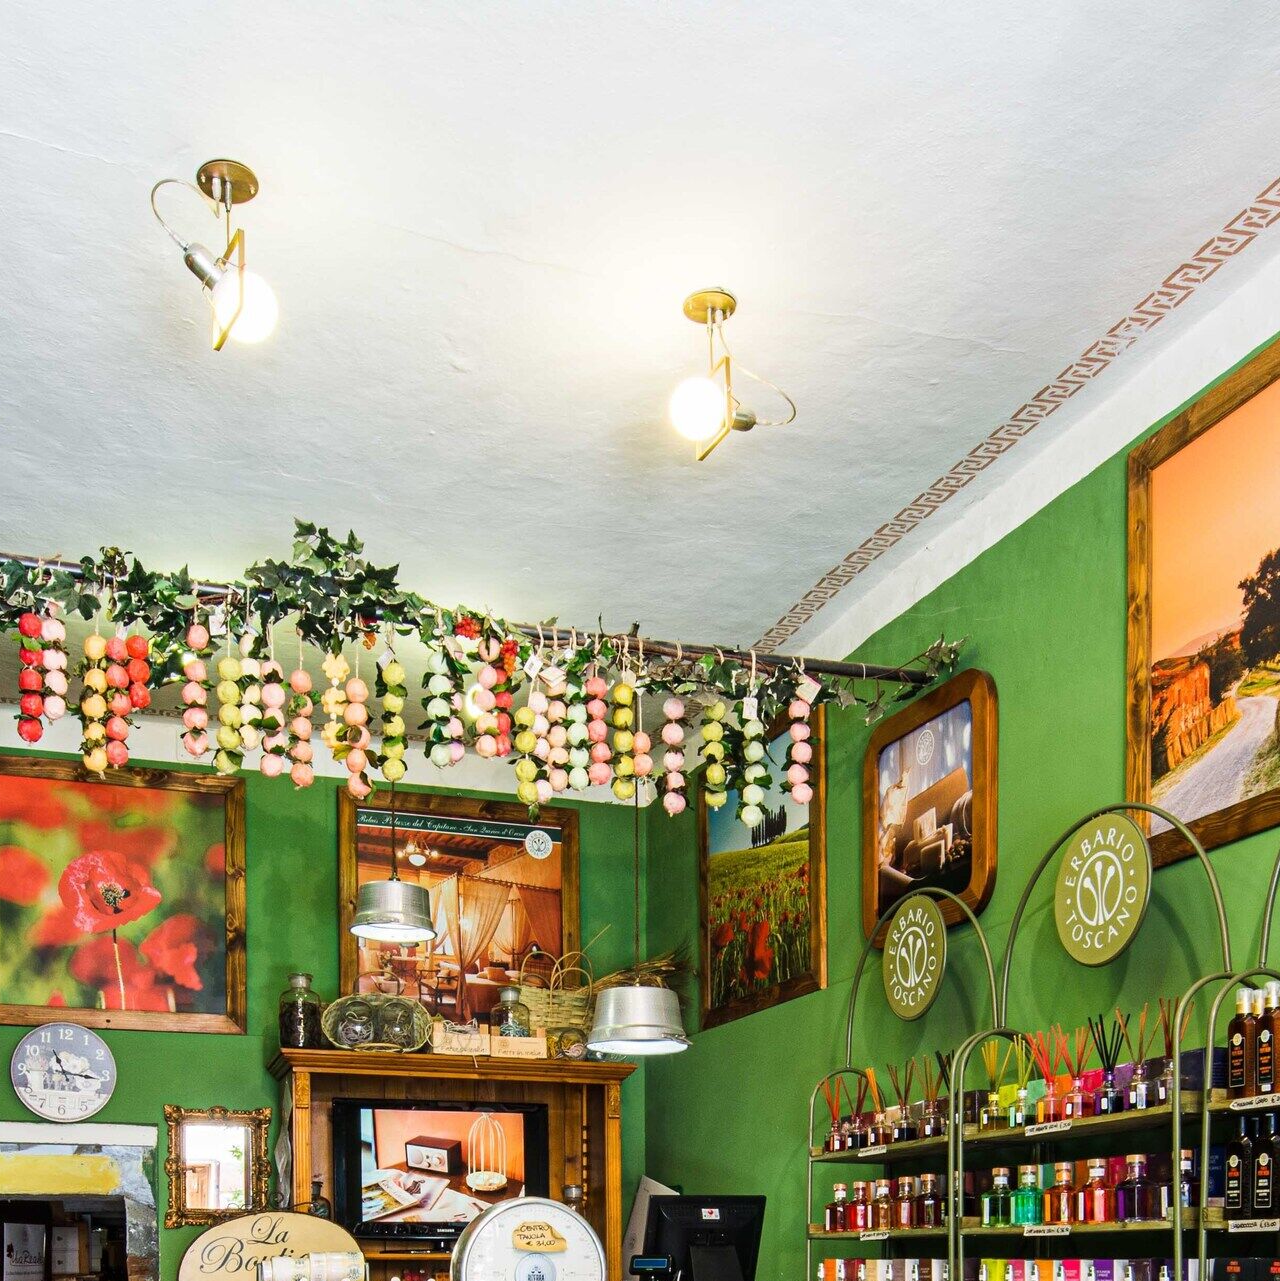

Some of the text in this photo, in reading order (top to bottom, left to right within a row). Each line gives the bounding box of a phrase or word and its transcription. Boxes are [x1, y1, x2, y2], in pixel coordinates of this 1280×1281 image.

[412, 819, 423, 828] del
[1065, 826, 1133, 887] ERBARIO
[1065, 881, 1138, 949] TOSCANO
[888, 906, 936, 960] ERBARIO
[888, 950, 942, 1005] TOSCANO
[40, 1029, 89, 1045] 11 12 1
[25, 1045, 104, 1060] 10 2
[17, 1062, 110, 1081] 9 3
[38, 1098, 87, 1115] 7 6 5
[246, 1215, 289, 1245] La
[519, 1224, 551, 1233] CENTRO
